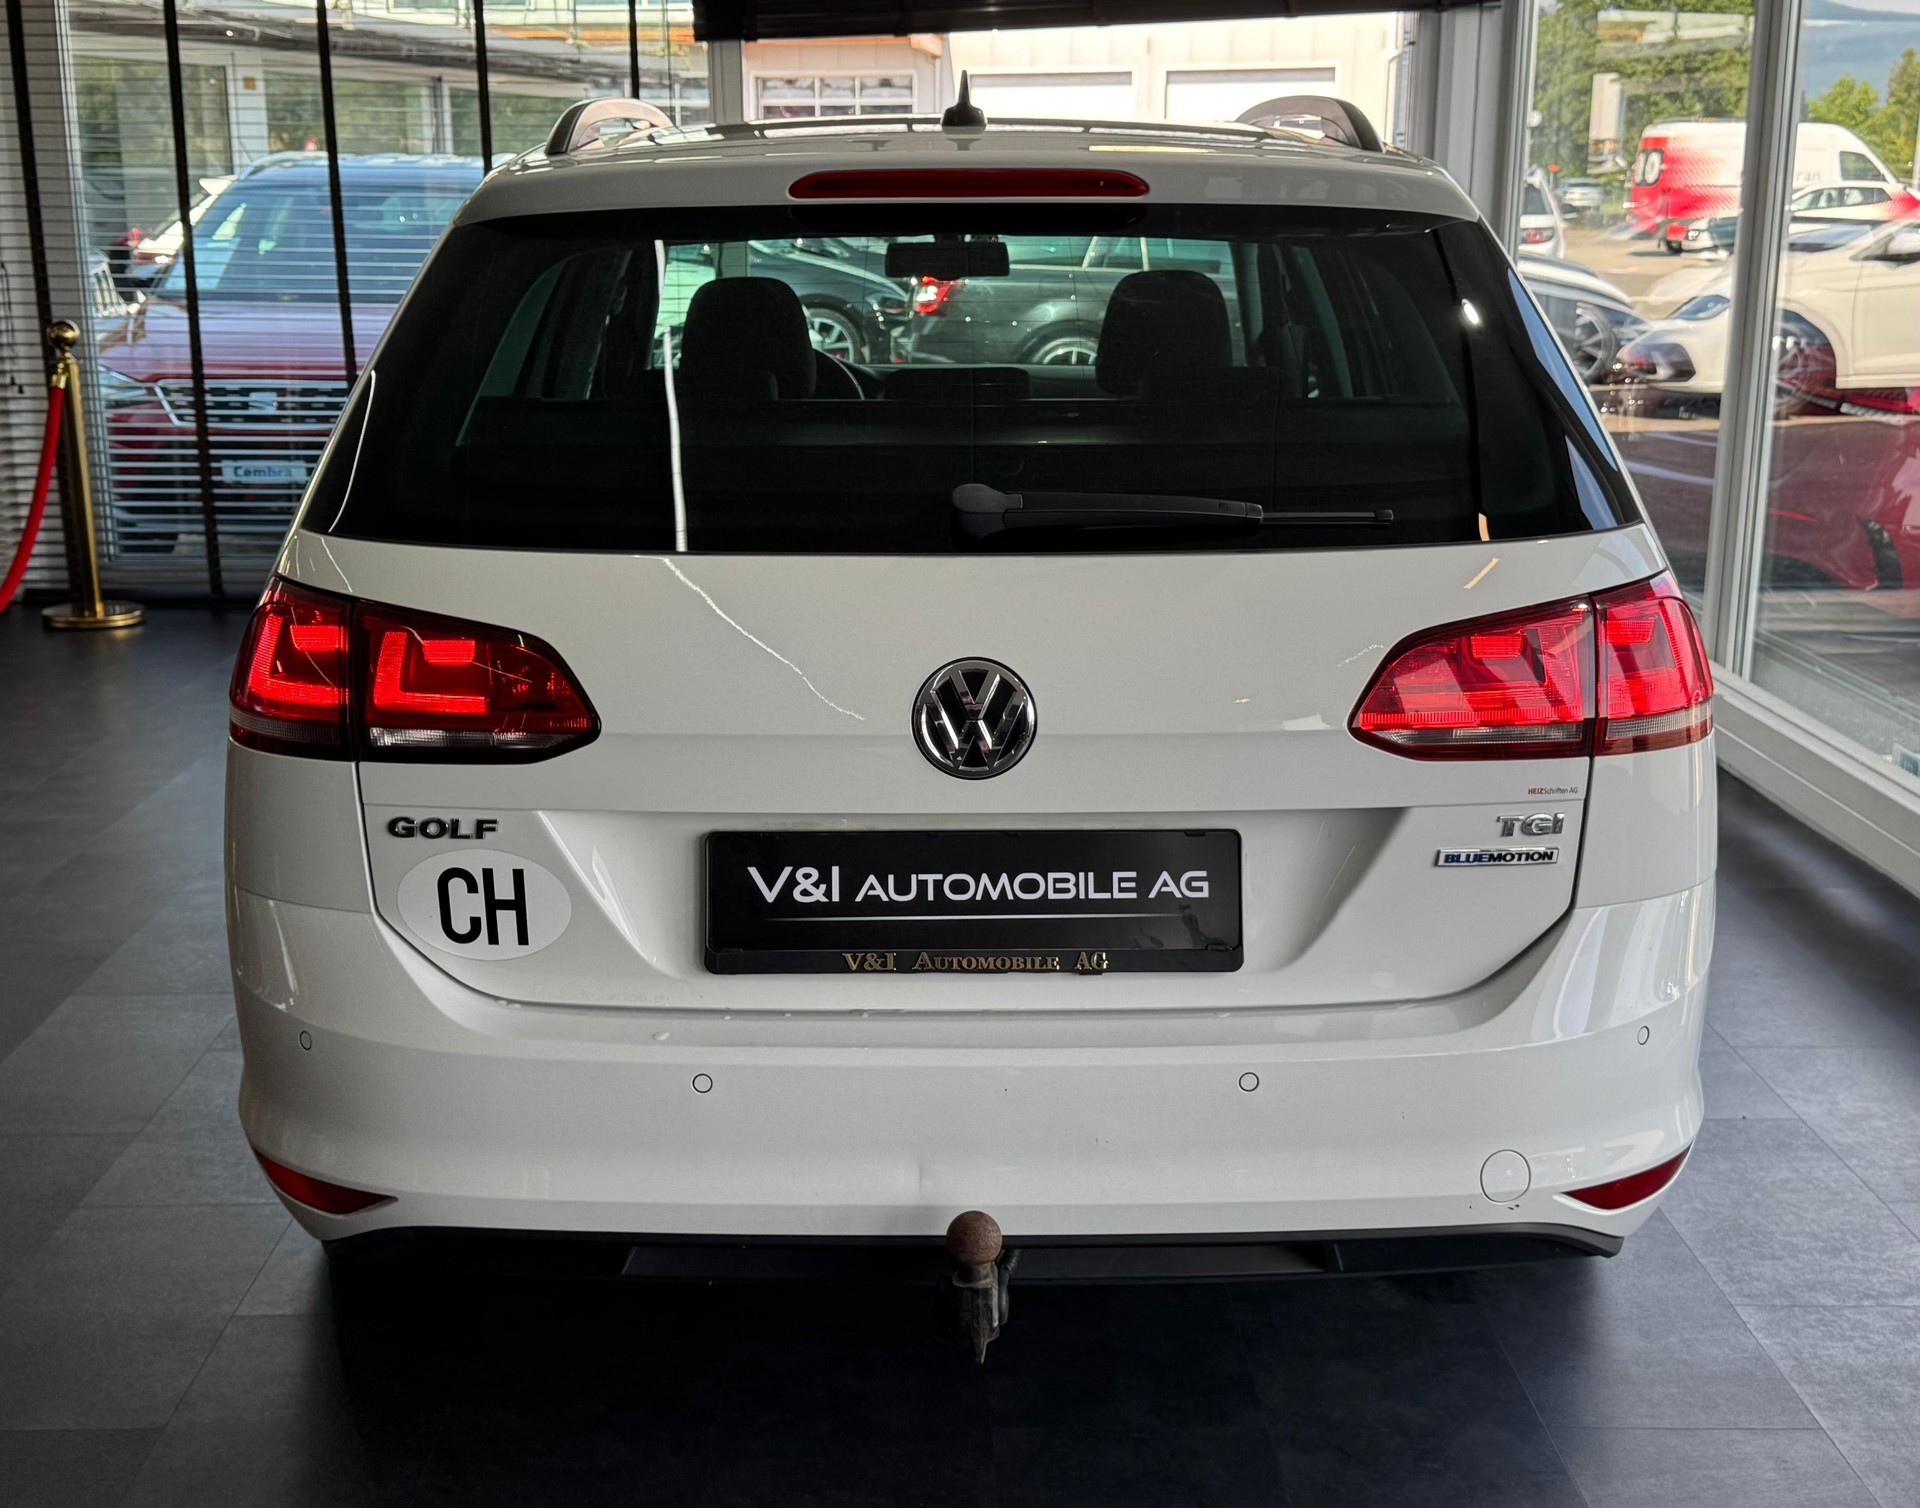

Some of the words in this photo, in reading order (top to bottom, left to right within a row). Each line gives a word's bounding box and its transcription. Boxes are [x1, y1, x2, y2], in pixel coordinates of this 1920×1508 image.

[233, 466, 293, 478] Cembra
[387, 816, 499, 839] GOLF
[1496, 812, 1565, 837] TGI
[1443, 850, 1554, 864] BLUEMOTION
[747, 866, 840, 904] V&I
[855, 871, 1137, 902] AUTOMOBILE
[1148, 870, 1209, 899] AG
[437, 867, 529, 946] CH
[842, 952, 897, 971] V&I
[1074, 951, 1109, 970] AG
